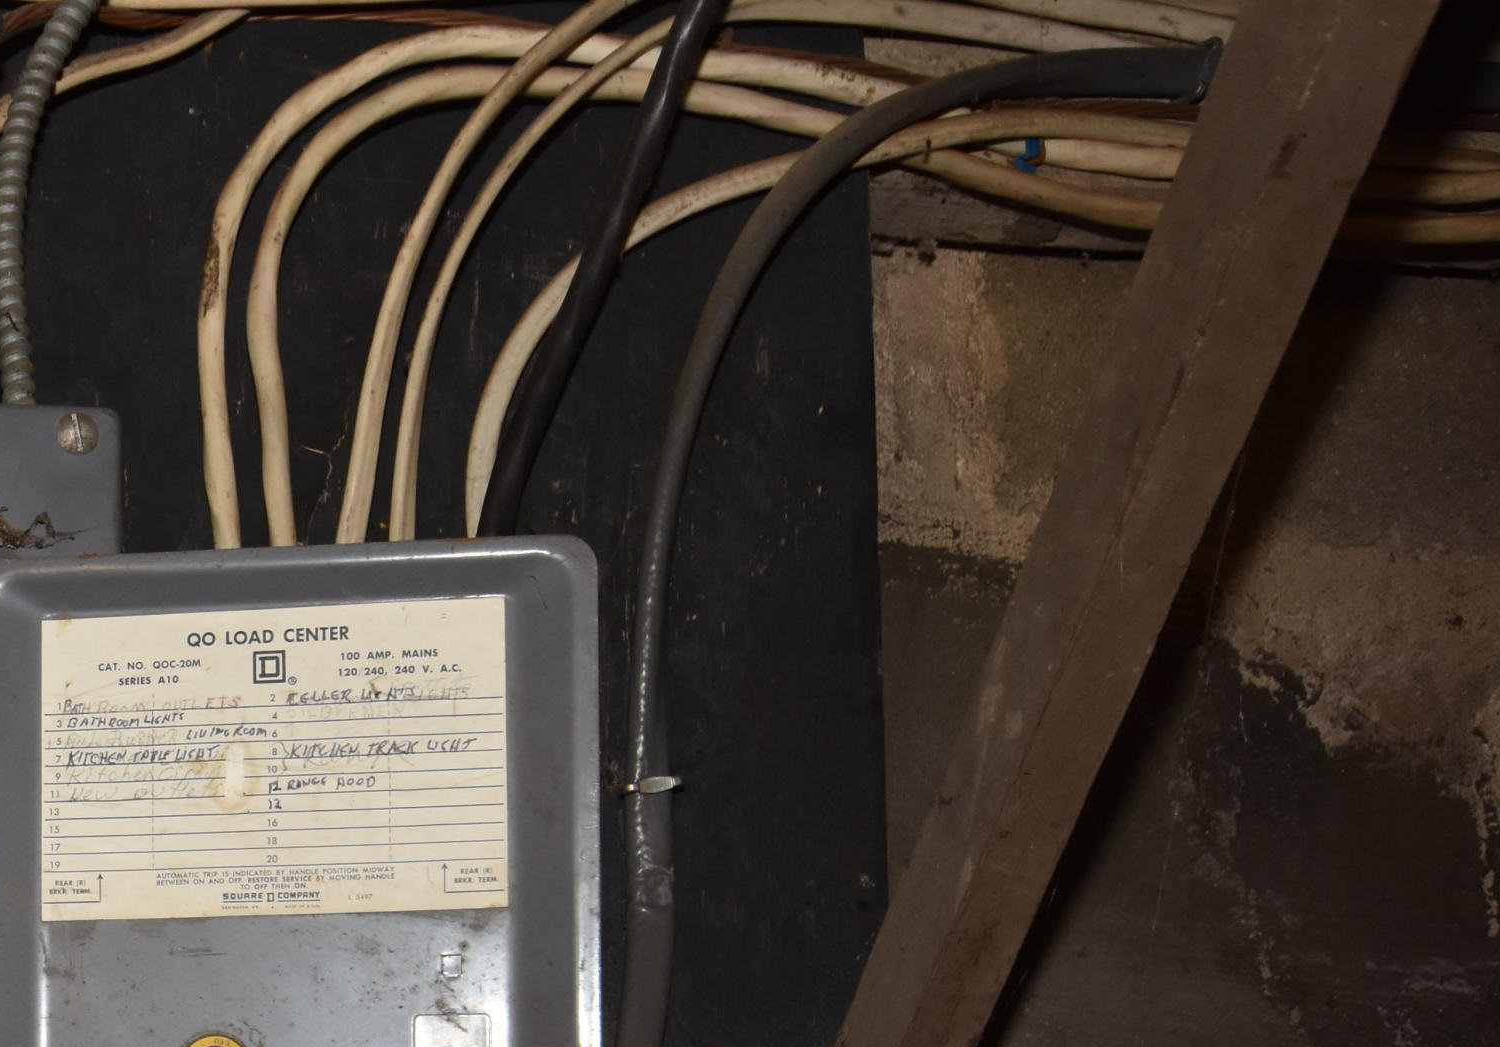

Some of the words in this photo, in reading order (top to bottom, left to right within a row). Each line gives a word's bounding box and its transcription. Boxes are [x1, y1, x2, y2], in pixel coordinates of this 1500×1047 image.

[187, 632, 216, 647] QO
[226, 630, 274, 645] LOAD
[284, 626, 349, 642] CENTER
[341, 652, 360, 661] 100
[367, 651, 395, 660] AMP.
[402, 649, 438, 658] MAINS
[98, 662, 121, 672] CAT.
[127, 661, 147, 670] NO.
[153, 660, 201, 670] QOC-20M
[395, 666, 415, 674] 240
[423, 665, 433, 673] V.
[440, 664, 462, 673] A.C.
[118, 677, 151, 686] SERIES
[158, 676, 179, 684] A10
[270, 694, 275, 702] 2
[56, 720, 62, 729] 3
[272, 730, 277, 738] 6
[56, 738, 61, 746] 5
[272, 748, 277, 756] 8
[56, 755, 61, 763] 7
[67, 749, 127, 767] KITCHEN
[268, 765, 278, 773] 10
[336, 776, 376, 790] HOOD
[50, 790, 60, 798] 11
[49, 808, 60, 816] 13
[267, 819, 278, 827] 16
[267, 837, 278, 845] 18
[50, 843, 60, 851] 17
[267, 855, 278, 863] 20
[50, 861, 61, 869] 19
[222, 892, 263, 900] SQUARE
[266, 892, 275, 902] D
[277, 891, 320, 899] COMPANY
